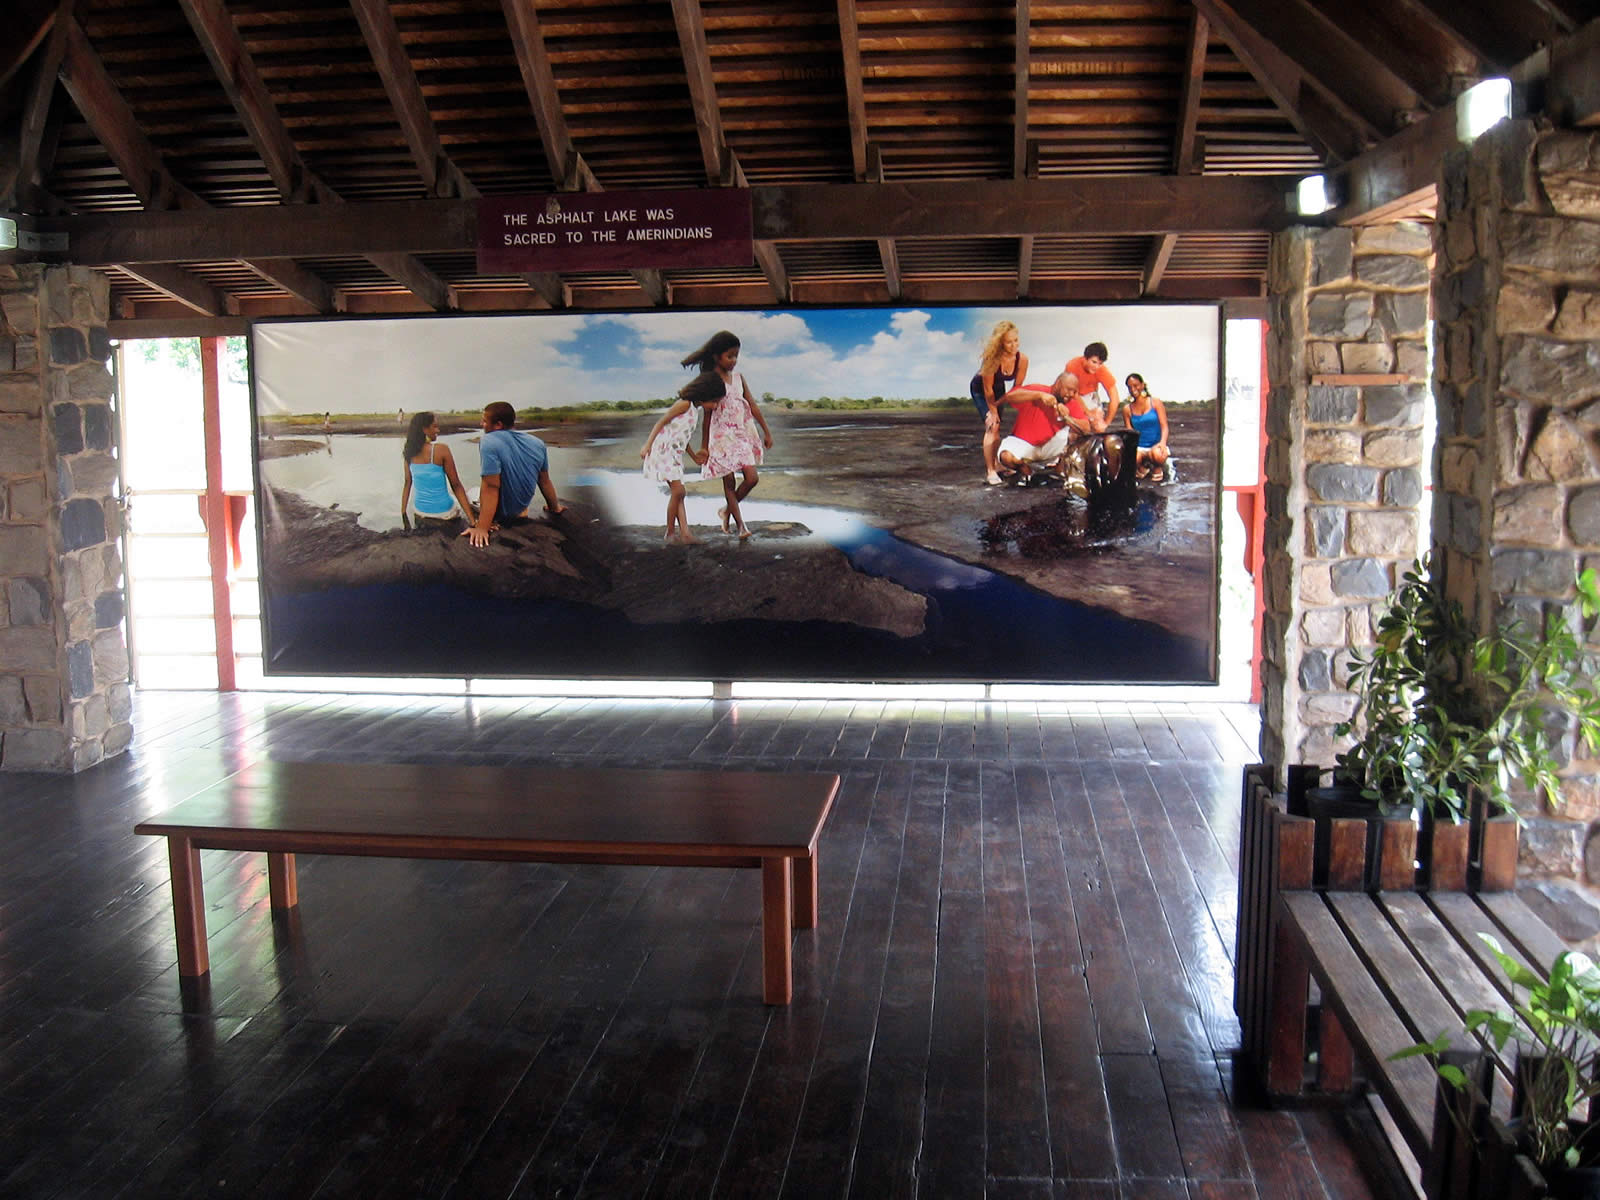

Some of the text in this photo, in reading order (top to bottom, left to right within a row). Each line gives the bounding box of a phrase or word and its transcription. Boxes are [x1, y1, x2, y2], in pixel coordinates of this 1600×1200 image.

[503, 208, 674, 226] THE ASPHALT LAKE WAS
[503, 227, 713, 246] SACRED TO THE AMERINDIANS
